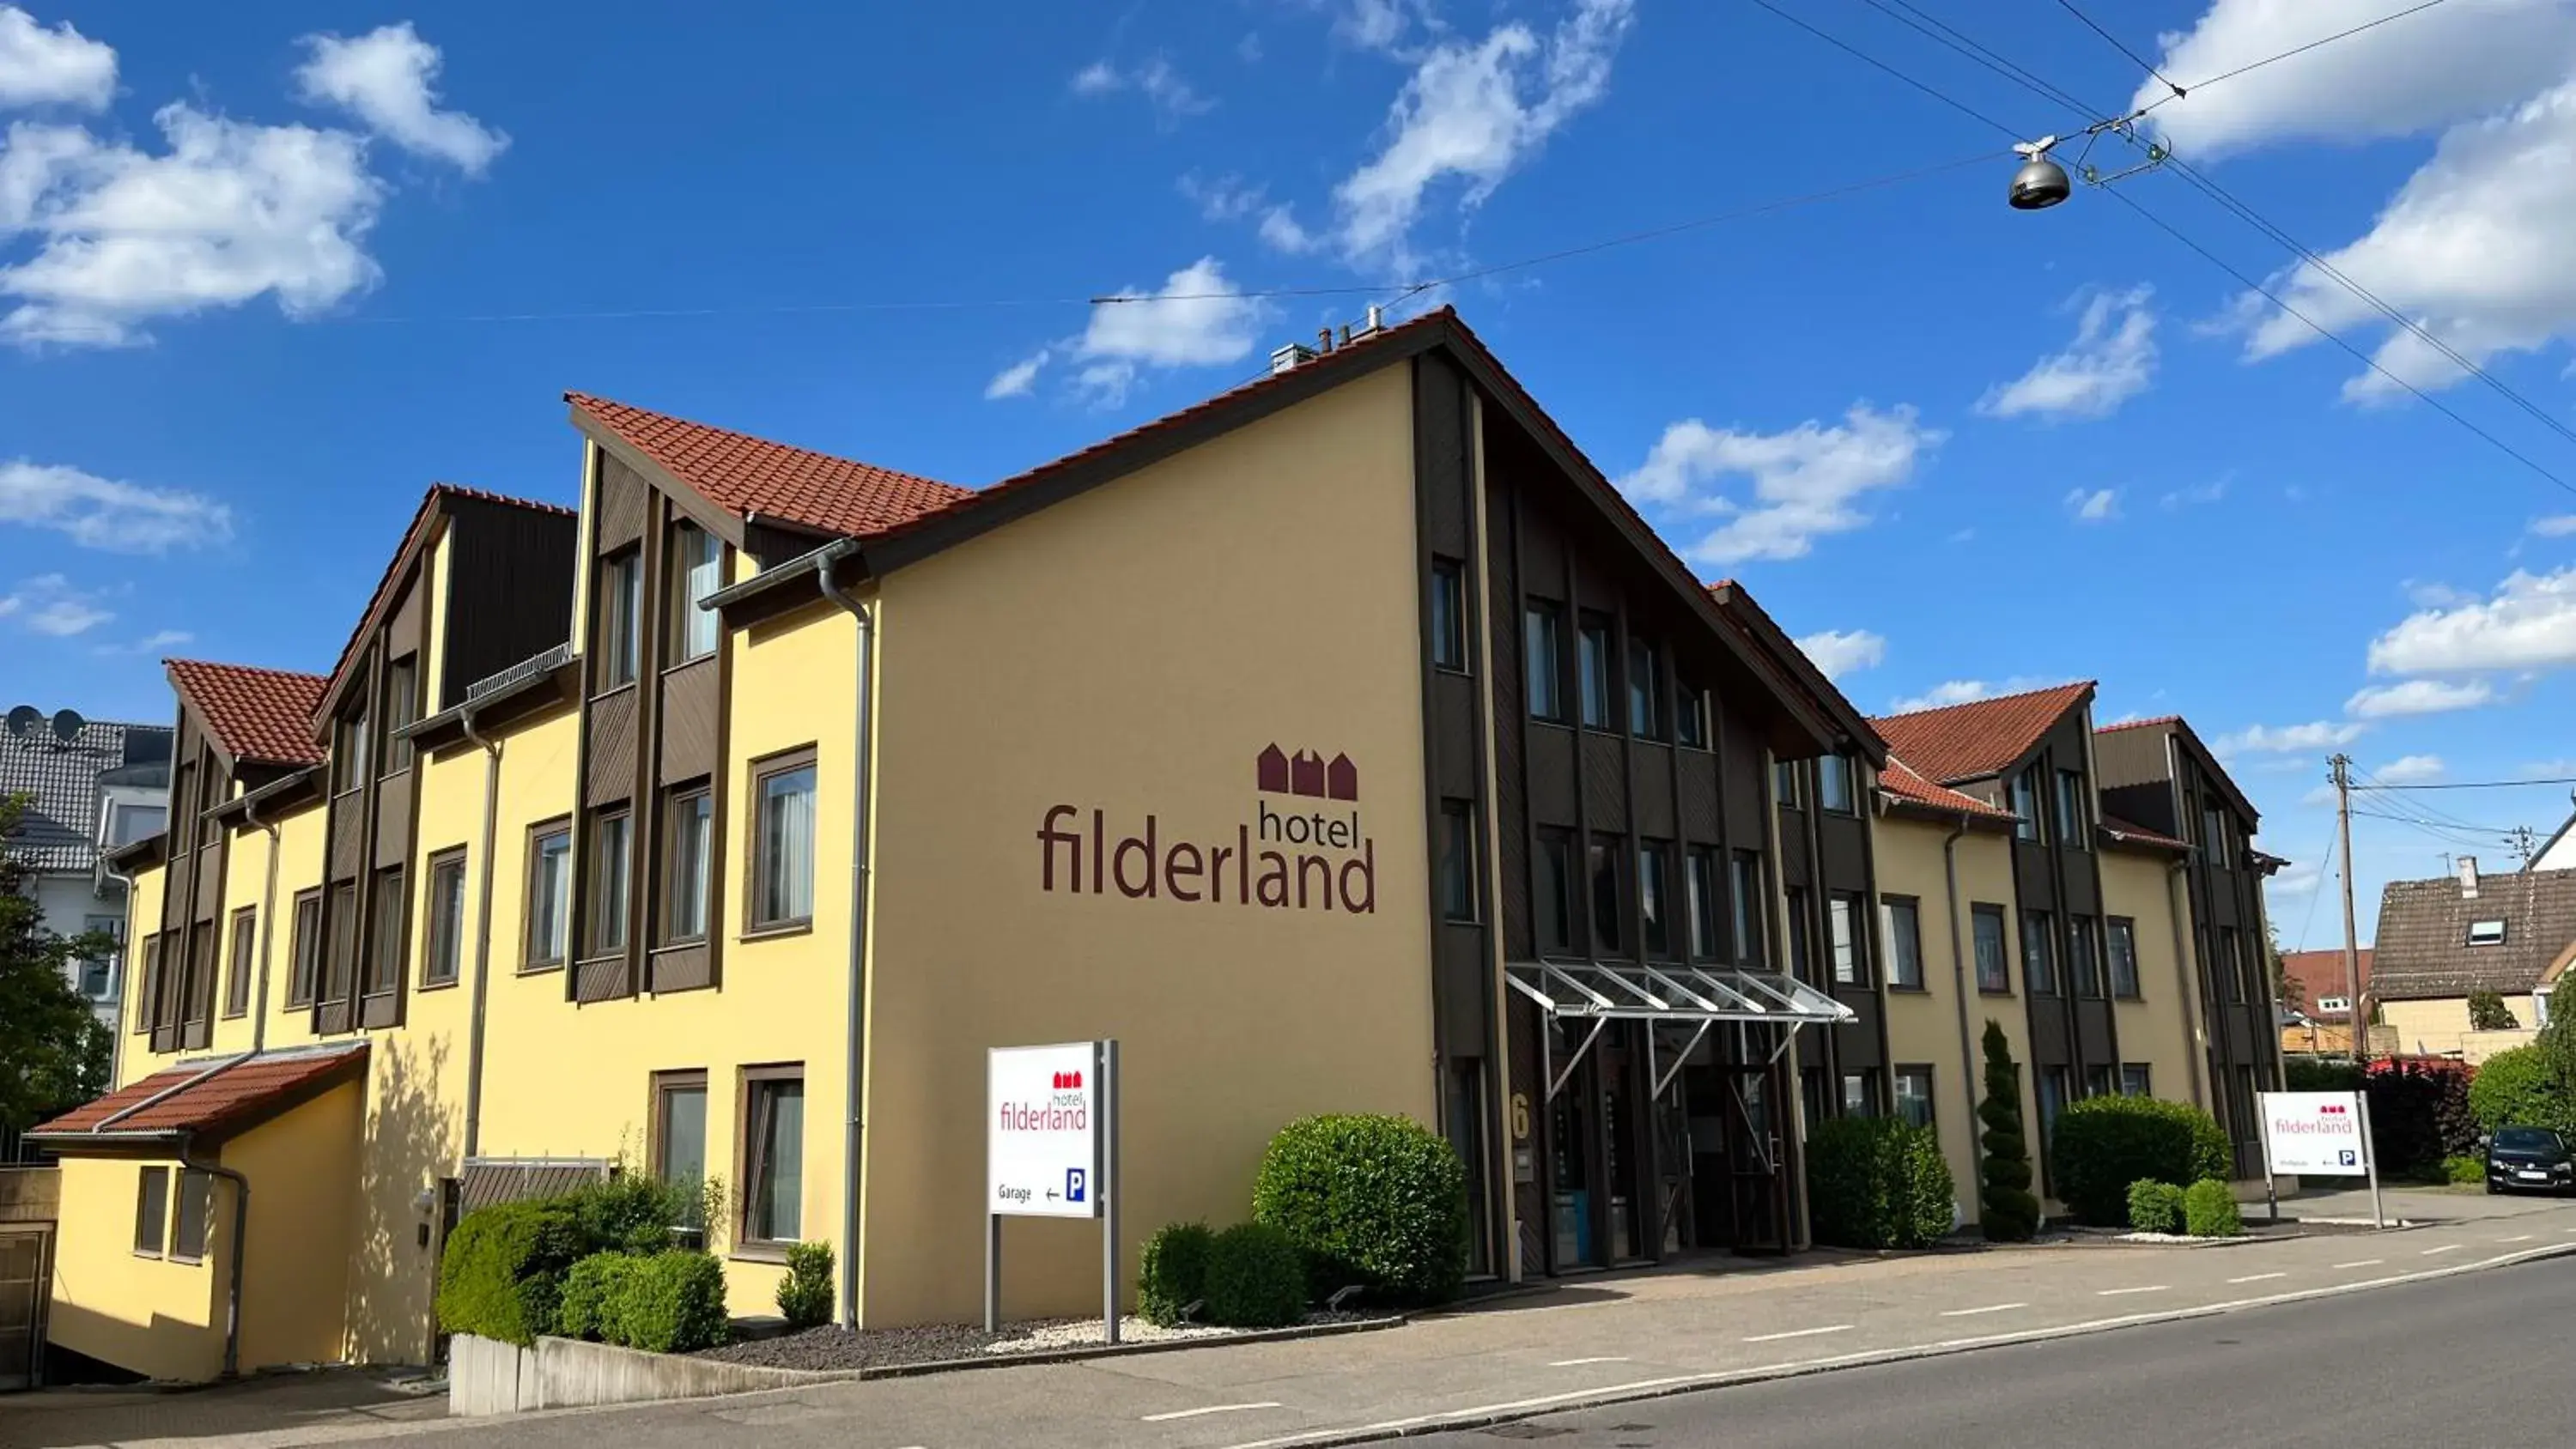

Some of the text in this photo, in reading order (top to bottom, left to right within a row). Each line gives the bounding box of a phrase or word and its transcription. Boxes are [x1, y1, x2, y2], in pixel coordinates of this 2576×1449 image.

[1259, 800, 1358, 849] hotel
[1036, 804, 1375, 914] filderland
[1053, 1092, 1084, 1106] hotel
[1000, 1101, 1086, 1131] filderland
[1511, 1093, 1529, 1139] 6
[2275, 1119, 2353, 1135] filderland
[2342, 1151, 2354, 1166] P
[999, 1184, 1032, 1203] Garage
[1069, 1171, 1083, 1198] P
